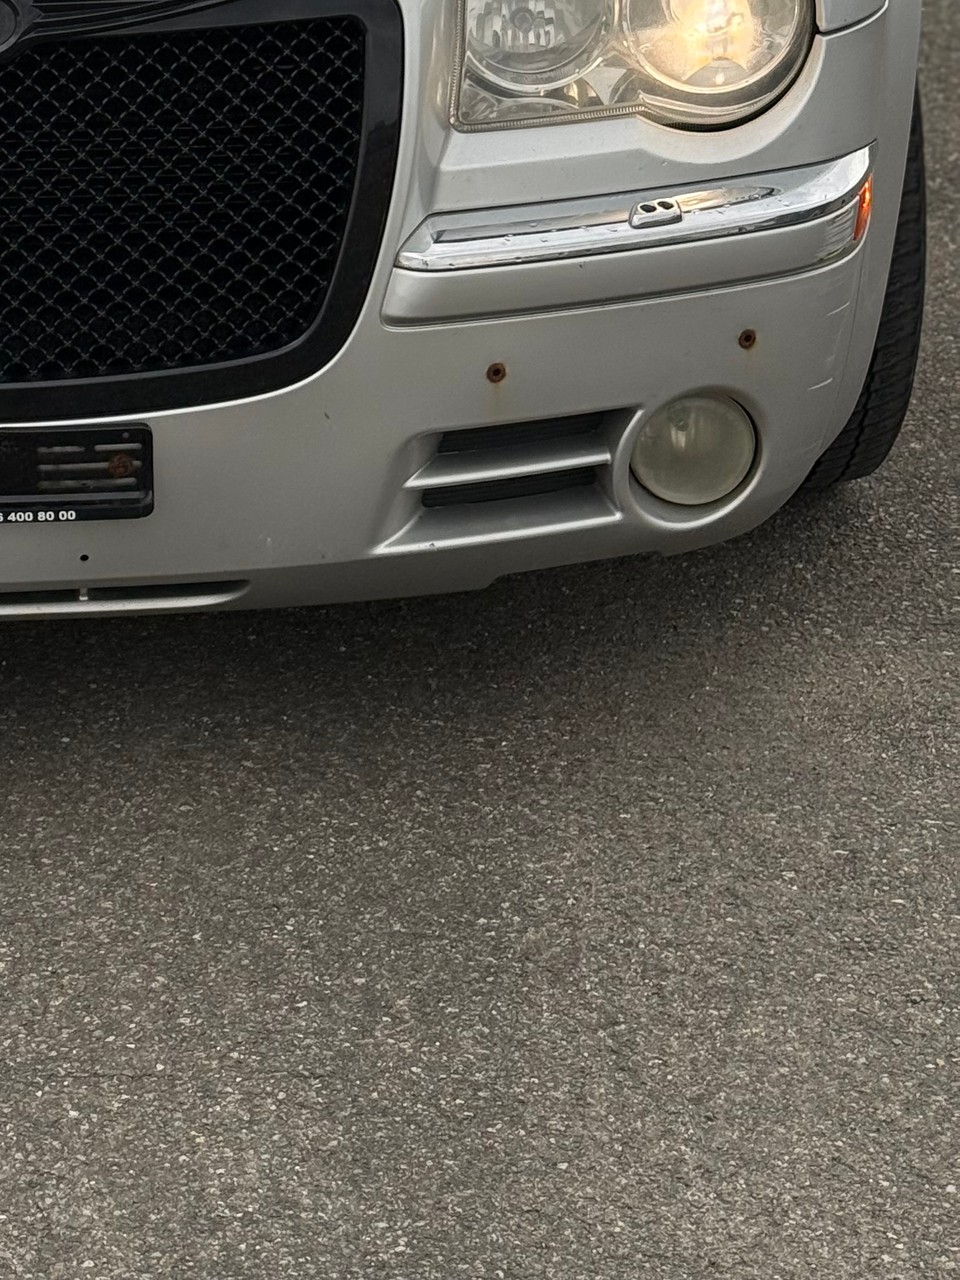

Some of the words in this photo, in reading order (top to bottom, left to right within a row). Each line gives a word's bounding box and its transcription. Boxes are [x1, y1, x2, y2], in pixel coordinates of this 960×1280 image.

[7, 511, 33, 522] 400
[37, 511, 55, 521] 80
[58, 510, 76, 521] 00
